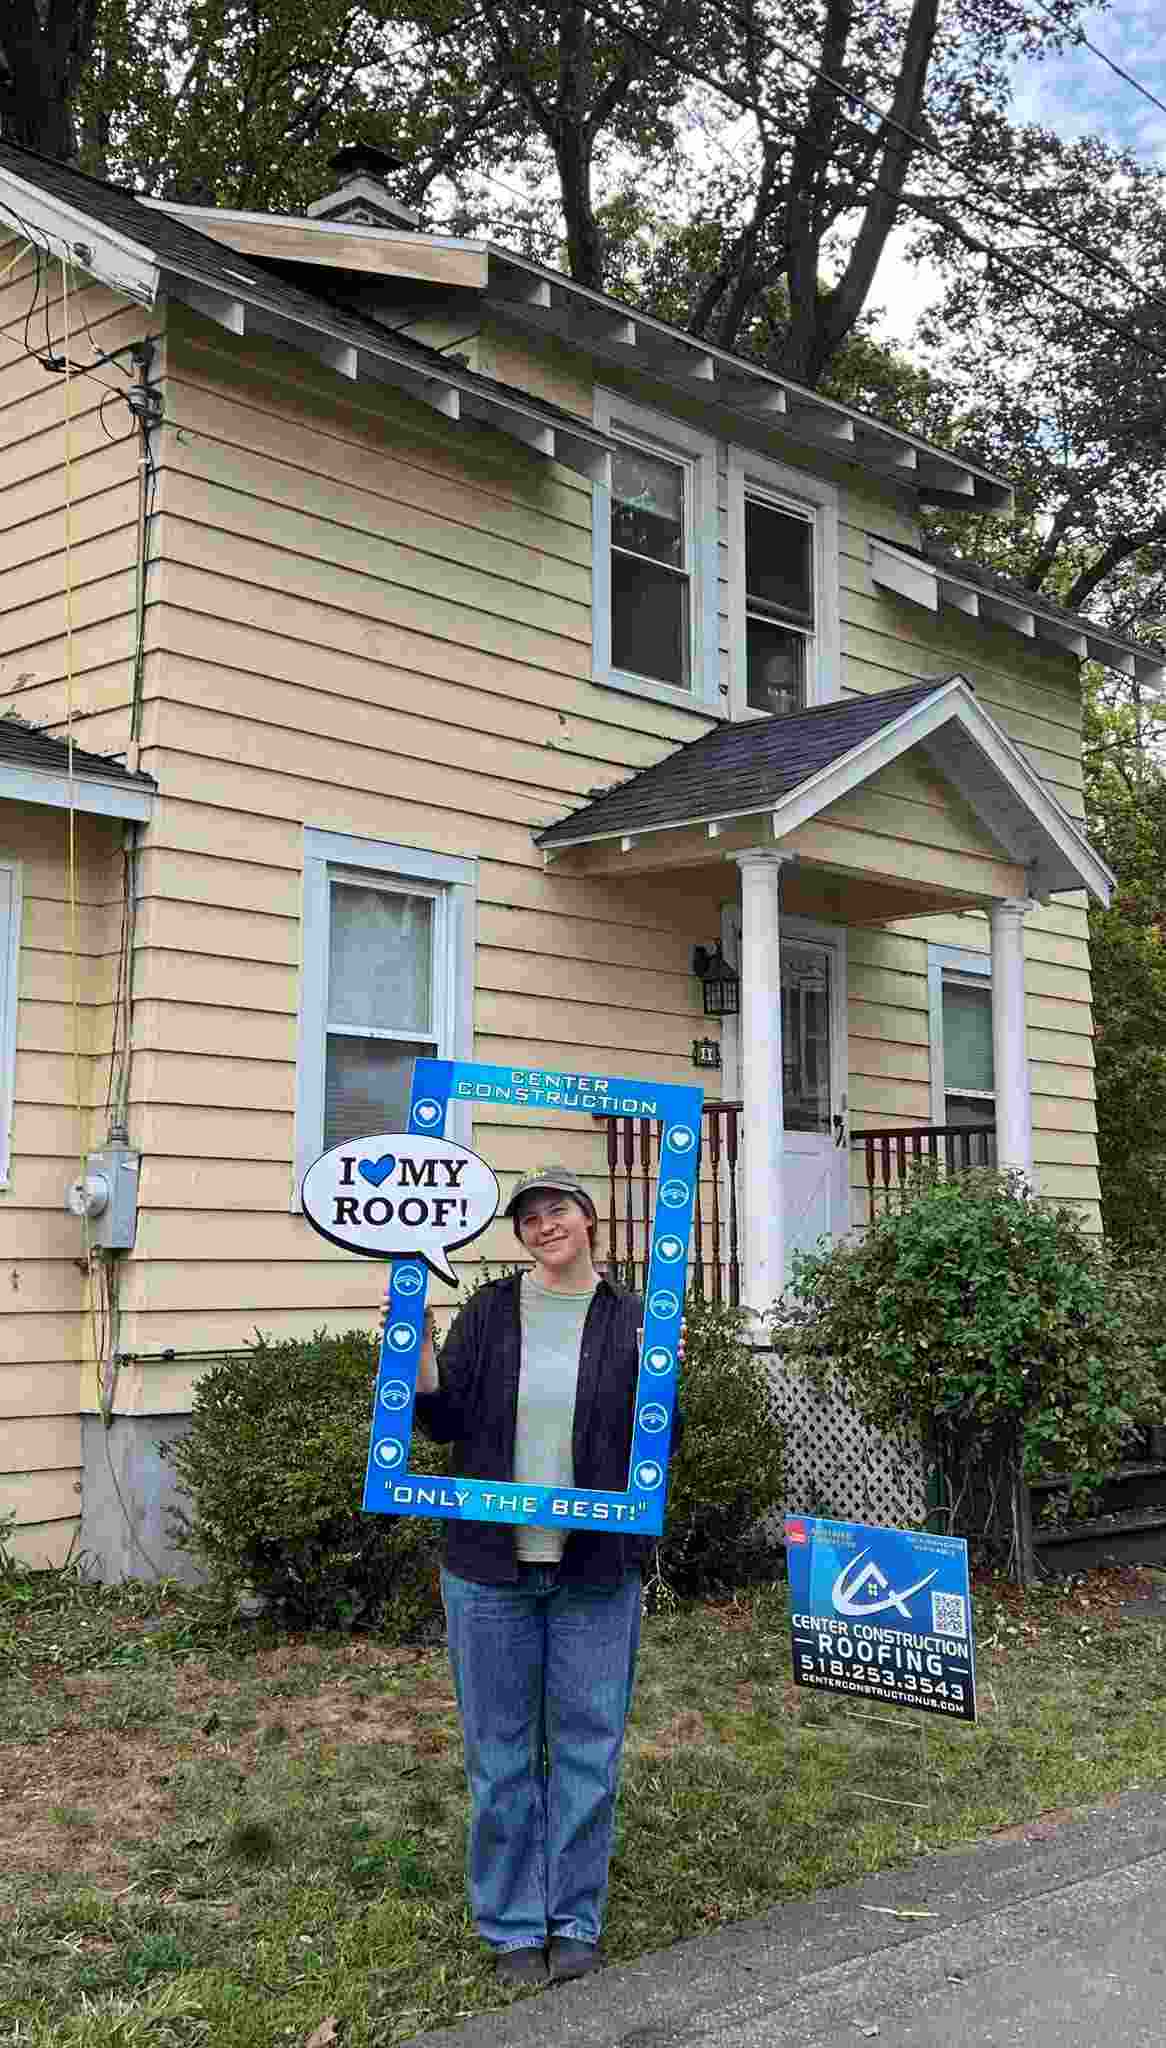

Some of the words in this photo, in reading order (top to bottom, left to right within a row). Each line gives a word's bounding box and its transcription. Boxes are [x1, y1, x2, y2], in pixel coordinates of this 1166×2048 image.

[456, 1081, 657, 1114] CONSTRUCTION
[511, 1071, 609, 1092] CENTER
[339, 1157, 356, 1185] I
[397, 1158, 468, 1187] MY
[332, 1197, 468, 1227] ROOF!
[384, 1480, 471, 1507] "ONLY
[482, 1494, 537, 1513] THE
[552, 1496, 648, 1521] BEST!"
[791, 1613, 848, 1636] CENTER
[853, 1624, 968, 1659] CONSTRUCTION
[818, 1634, 943, 1676] ROOFING
[801, 1655, 964, 1701] 518.253.3543
